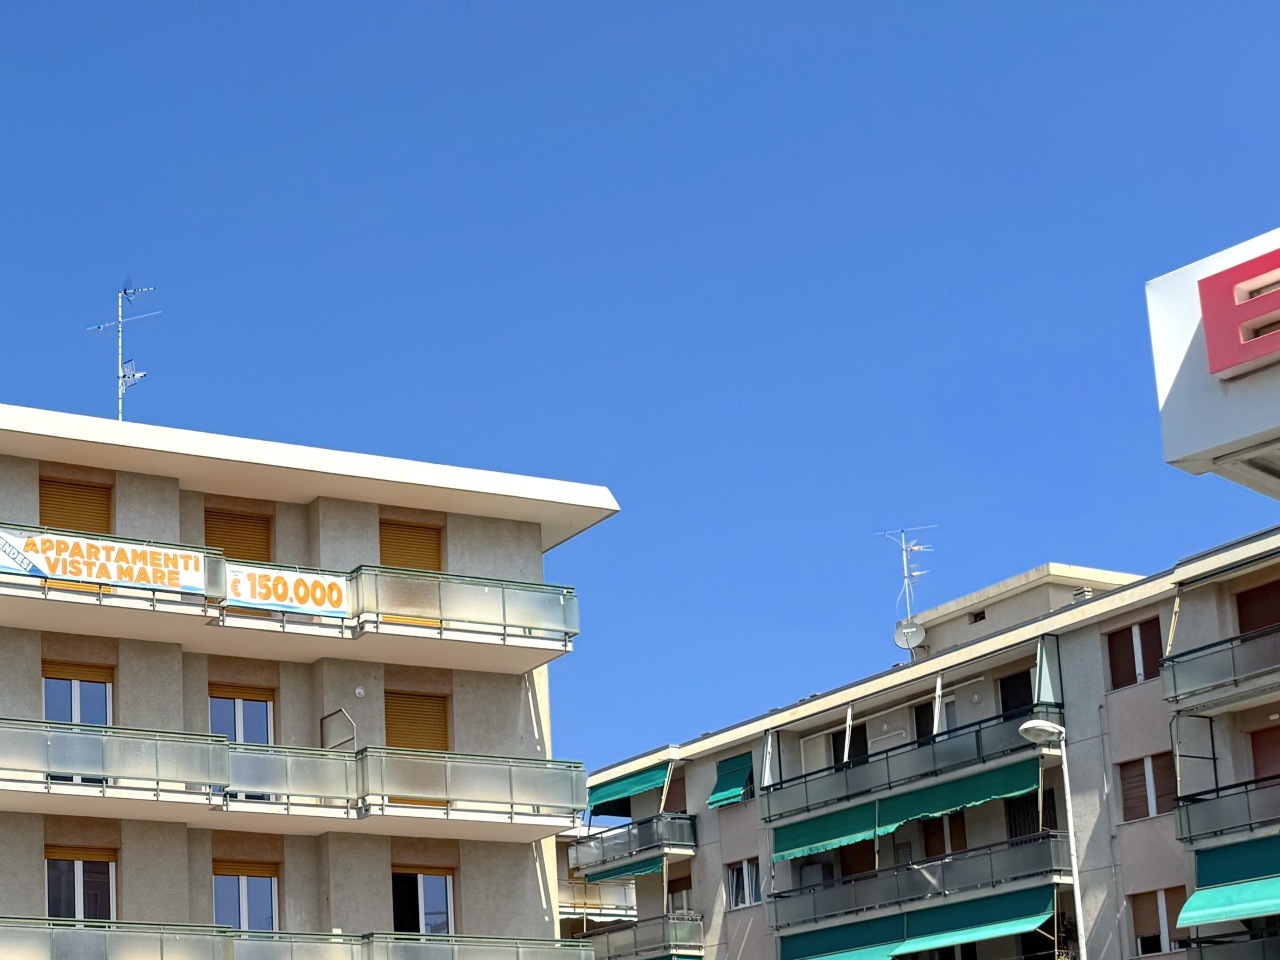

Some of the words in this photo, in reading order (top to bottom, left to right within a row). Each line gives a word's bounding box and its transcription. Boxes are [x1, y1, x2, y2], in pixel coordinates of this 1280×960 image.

[23, 537, 199, 572] APPARTAMENTI
[44, 556, 111, 581] VISTA
[116, 564, 180, 588] MARE
[230, 578, 241, 597] €
[247, 572, 343, 608] 150.000
